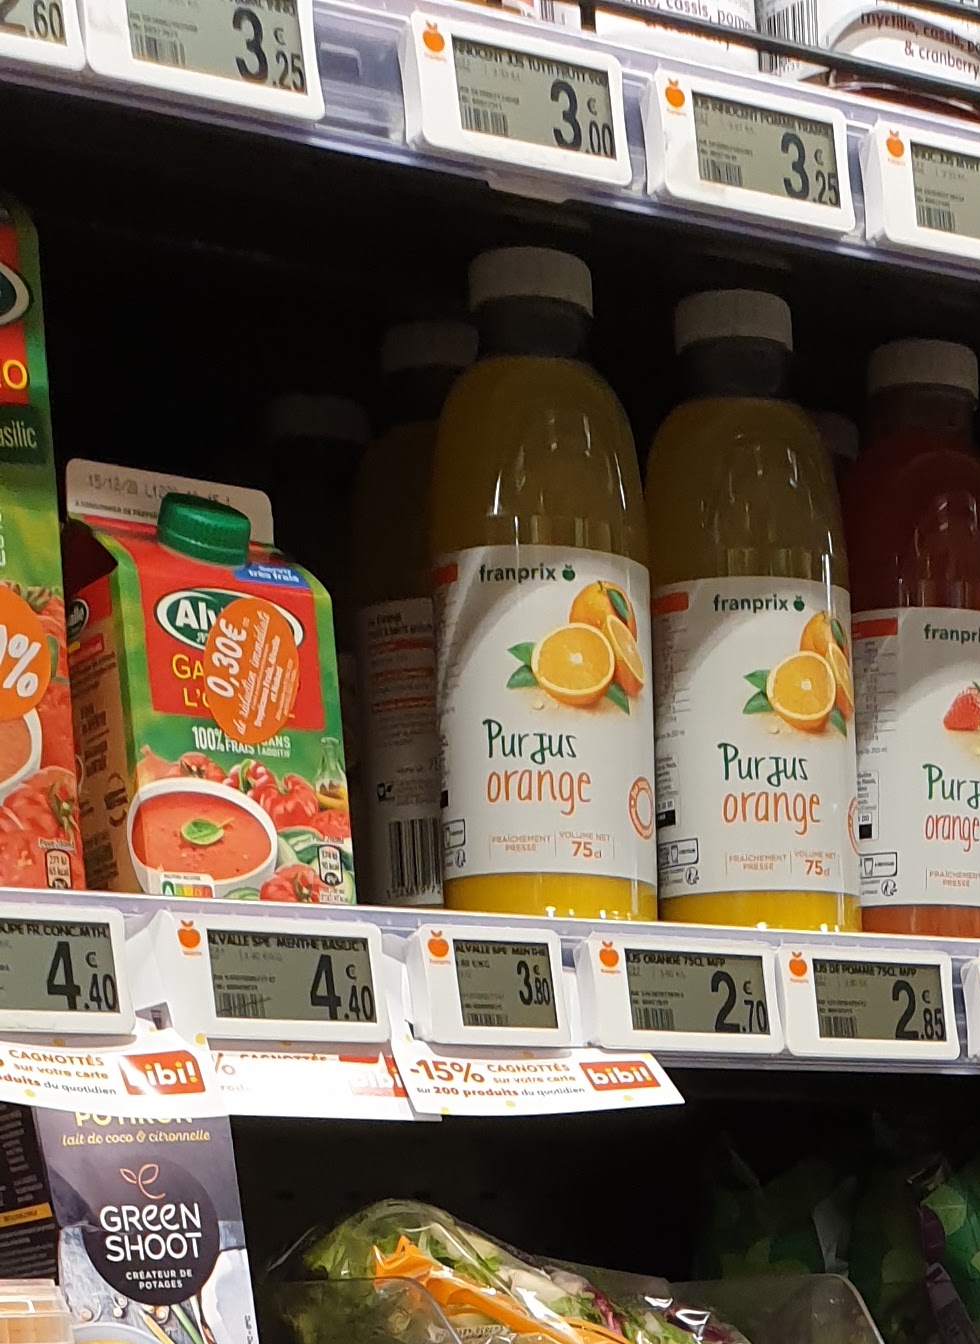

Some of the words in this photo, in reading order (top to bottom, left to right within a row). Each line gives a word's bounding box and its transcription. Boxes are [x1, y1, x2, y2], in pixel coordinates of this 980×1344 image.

[919, 43, 980, 81] cranberry
[480, 563, 557, 585] franprix
[713, 594, 788, 614] franprix
[486, 767, 591, 816] orange
[723, 789, 821, 836] orange
[924, 815, 979, 853] orange
[9, 1049, 104, 1067] CAGNOTTÉS
[410, 1058, 485, 1084] -15%
[487, 1061, 570, 1074] CAGNOTTÉS
[586, 1063, 651, 1089] bibi!
[62, 1084, 117, 1096] quotidien
[62, 1132, 86, 1147] lait
[148, 1127, 211, 1144] citronnelle
[105, 1231, 203, 1264] SHOOT
[125, 1268, 173, 1282] CRÉATEUR
[138, 1278, 183, 1290] POTAGES
